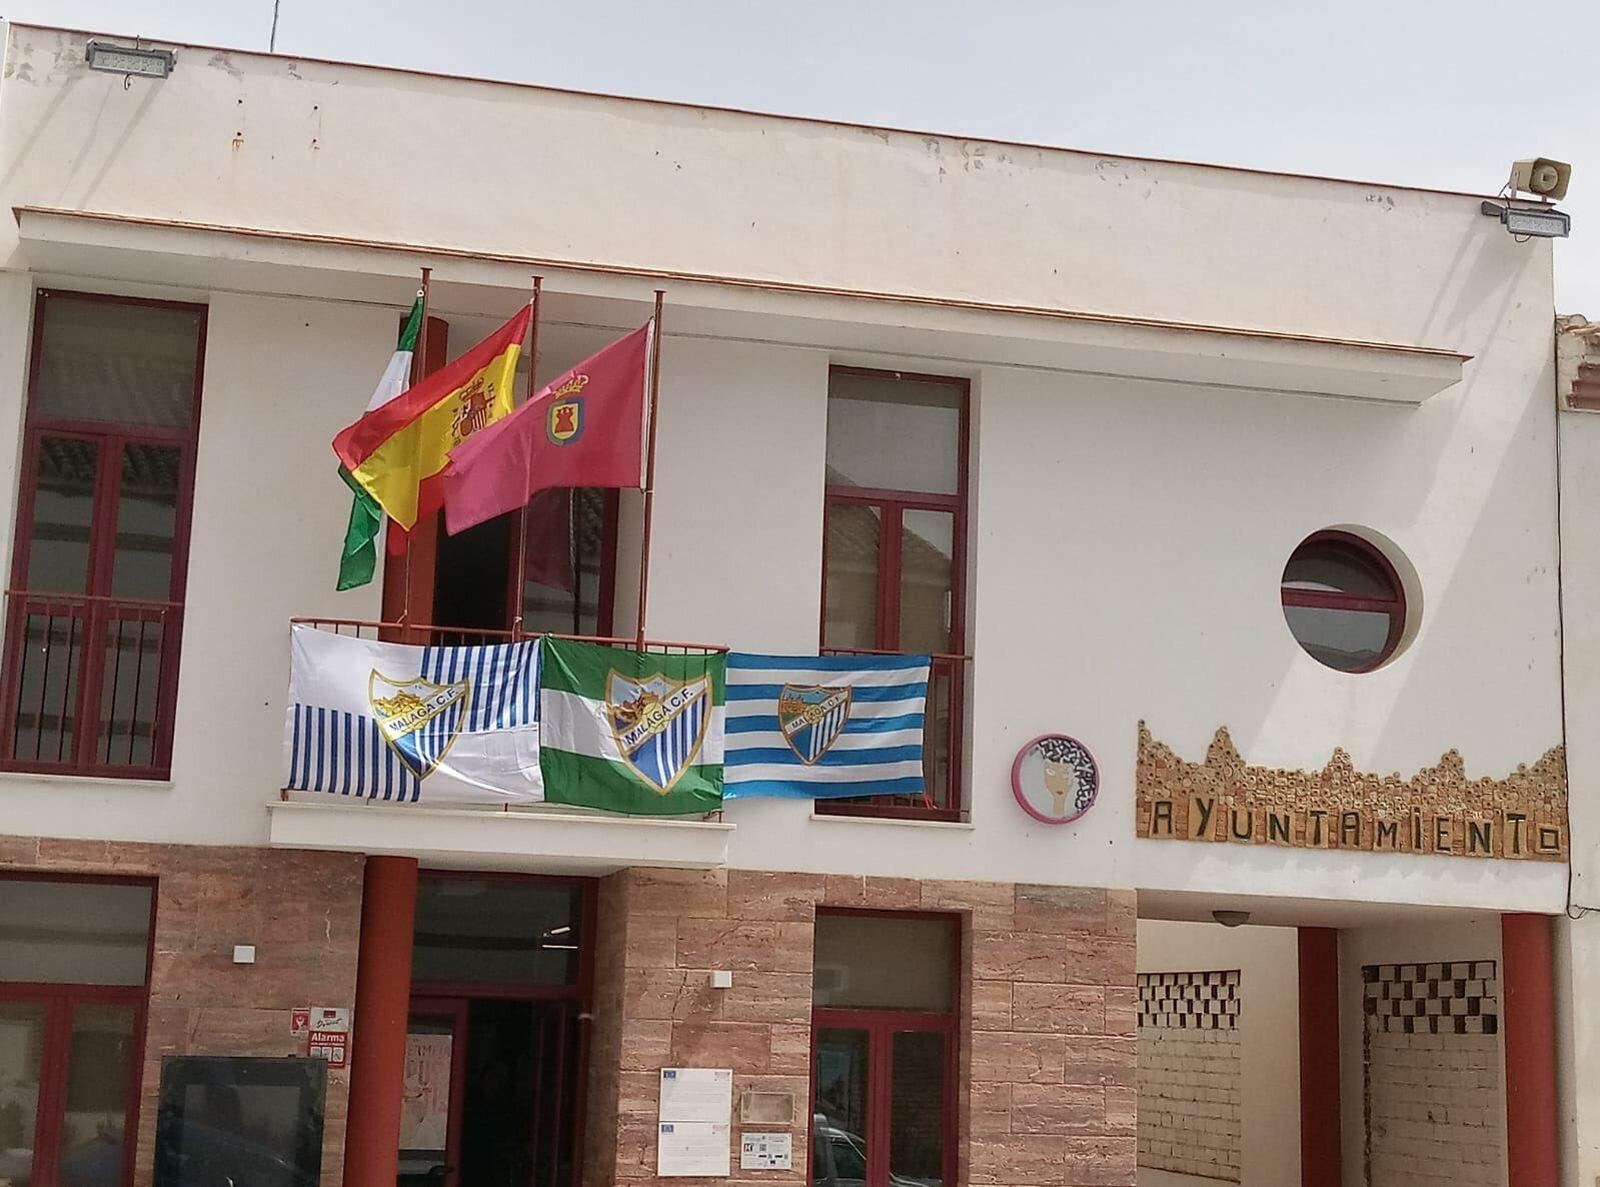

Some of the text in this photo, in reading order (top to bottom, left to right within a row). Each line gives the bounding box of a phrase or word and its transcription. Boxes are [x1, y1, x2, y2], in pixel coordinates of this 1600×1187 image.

[389, 703, 436, 731] MALAGA
[624, 705, 672, 744] MALAGA
[311, 1032, 345, 1042] Alarma
